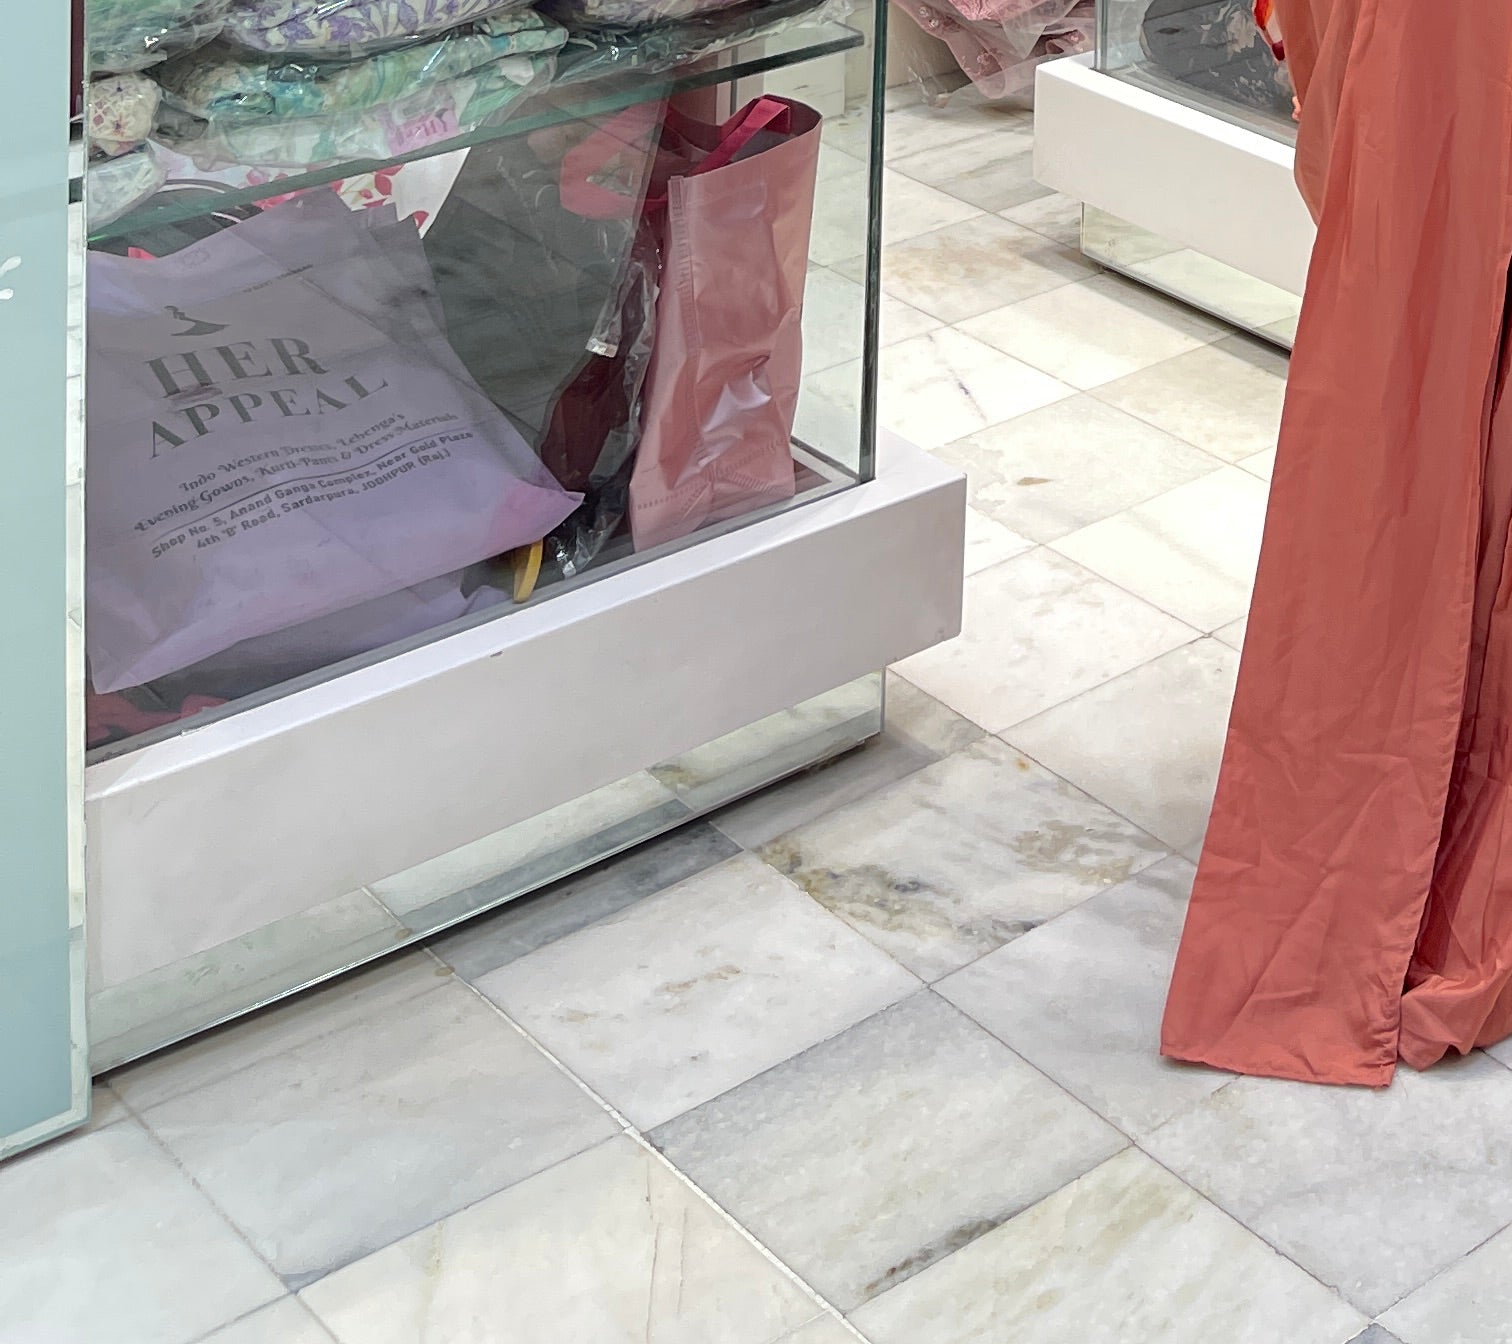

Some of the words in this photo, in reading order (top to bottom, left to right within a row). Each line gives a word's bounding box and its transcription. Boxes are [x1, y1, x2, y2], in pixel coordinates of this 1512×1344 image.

[145, 336, 329, 399] HER
[150, 374, 389, 460] APPEAL
[133, 497, 200, 532] Evening
[199, 475, 256, 503] Gowns,
[354, 432, 395, 454] Dress
[151, 534, 186, 559] Shop
[212, 515, 228, 527] 5,
[229, 494, 273, 520] Anand
[274, 482, 316, 500] Ganga
[375, 452, 407, 471] Near
[409, 439, 438, 455] Gold
[438, 432, 474, 445] Plaza
[178, 472, 216, 492] Indo
[216, 450, 280, 473] Western
[197, 533, 221, 549] 4th
[361, 461, 417, 491] JODHPUR
